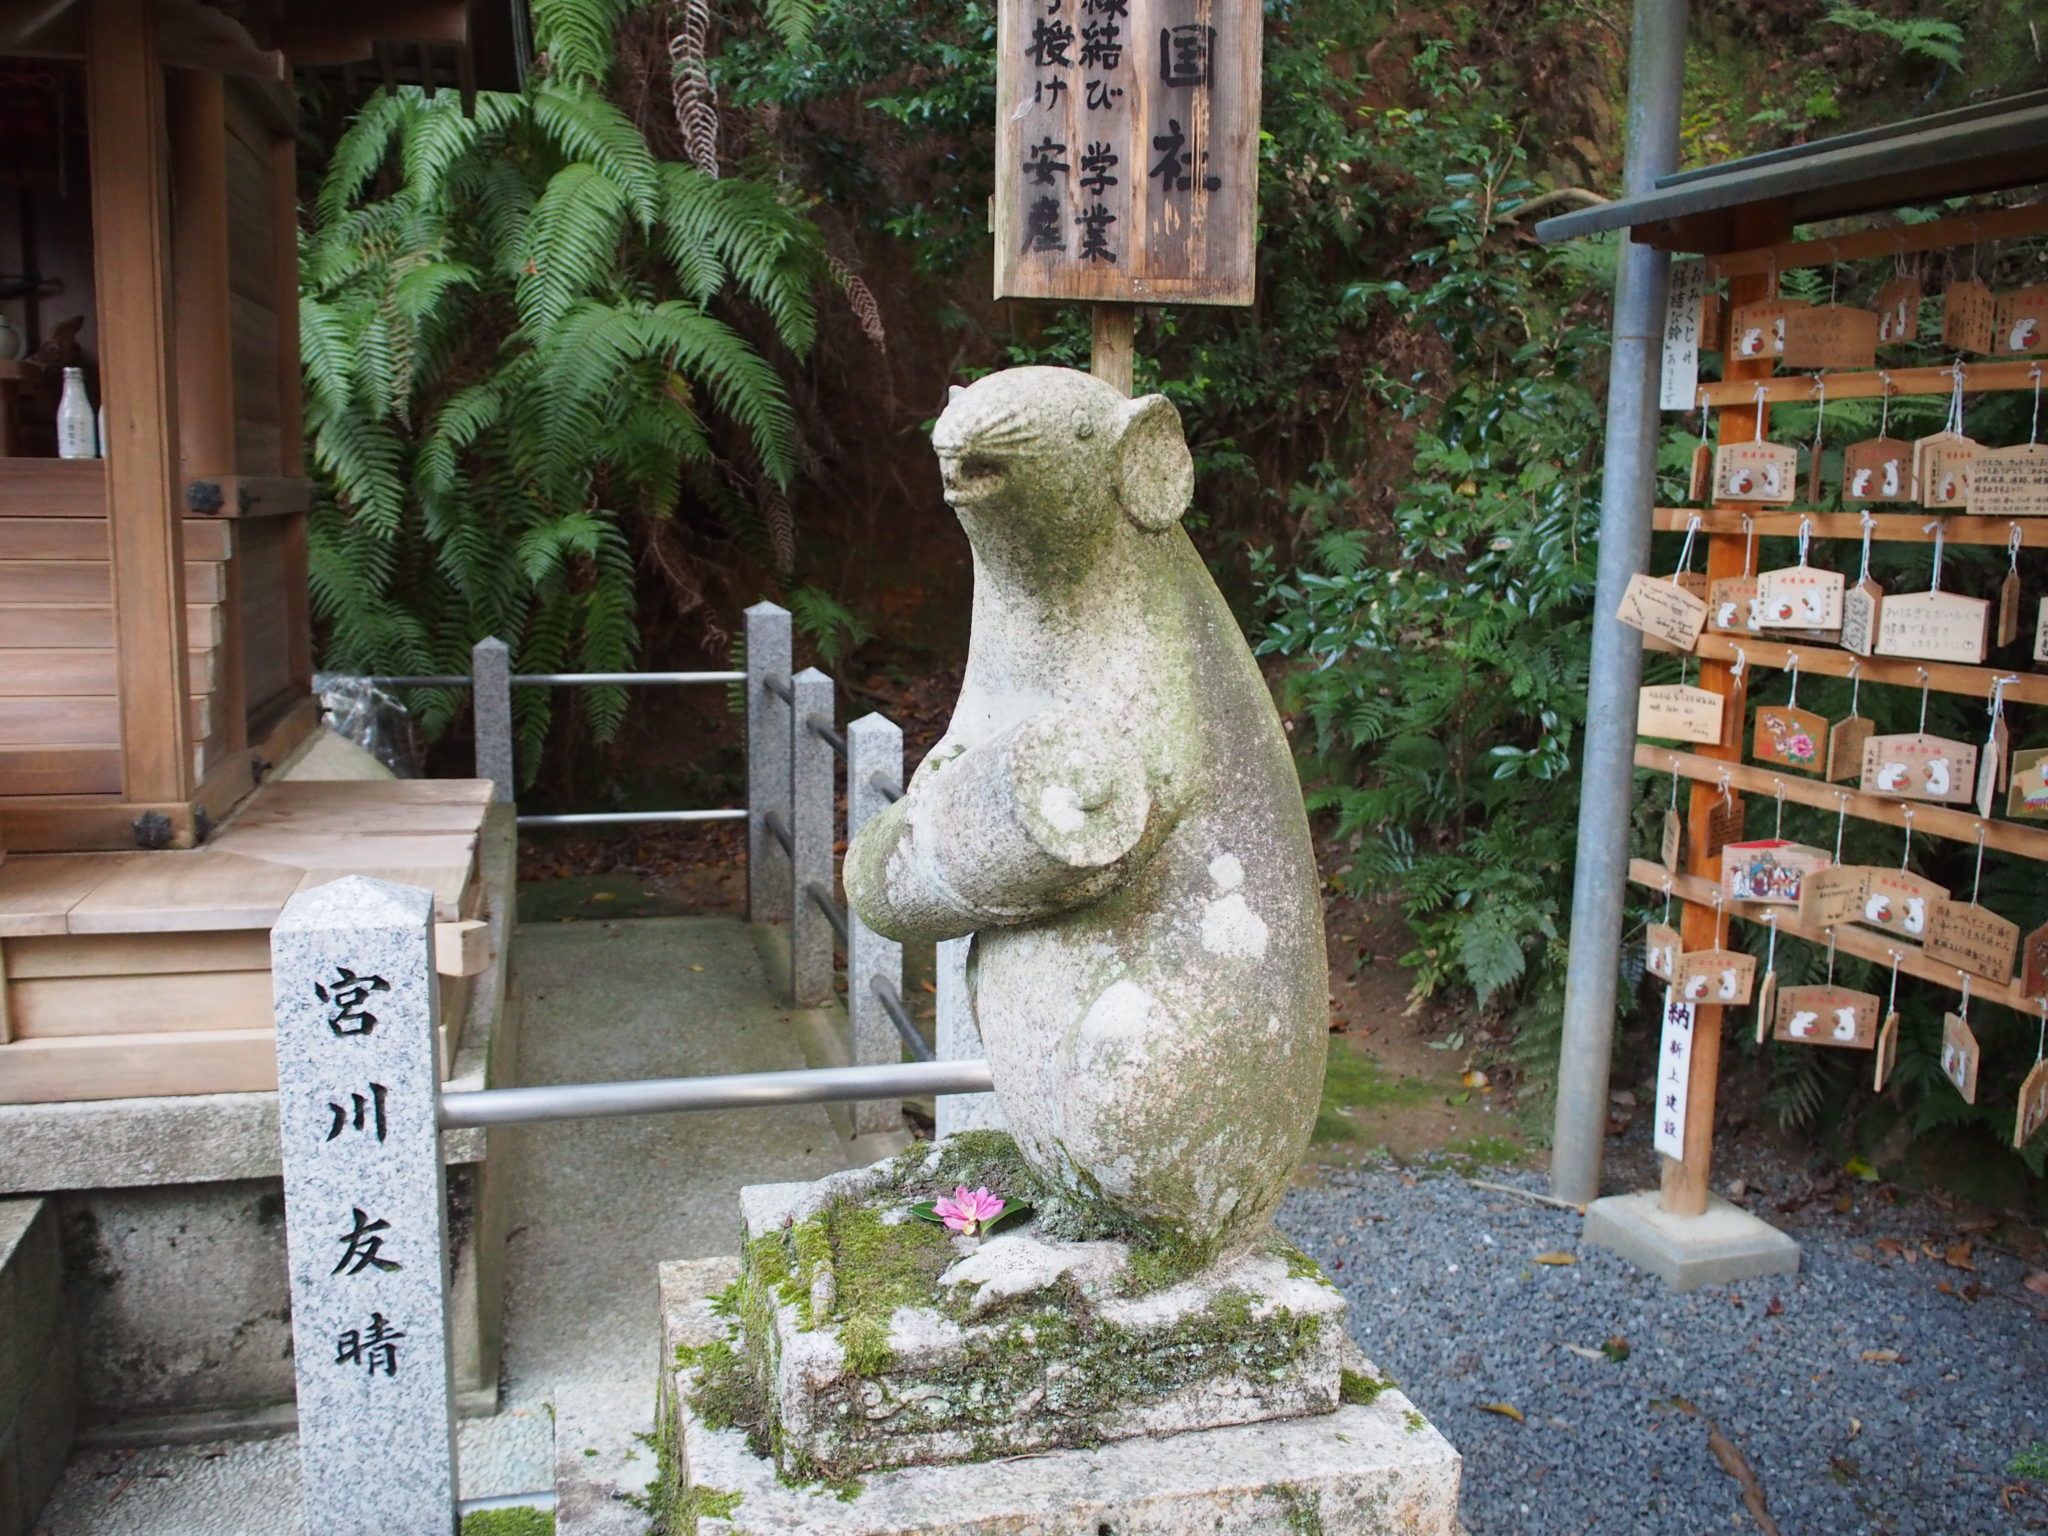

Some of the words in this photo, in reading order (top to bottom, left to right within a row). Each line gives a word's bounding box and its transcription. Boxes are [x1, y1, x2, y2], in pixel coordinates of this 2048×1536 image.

[1074, 141, 1118, 264] 学業
[314, 966, 405, 1378] 宮川友晴
